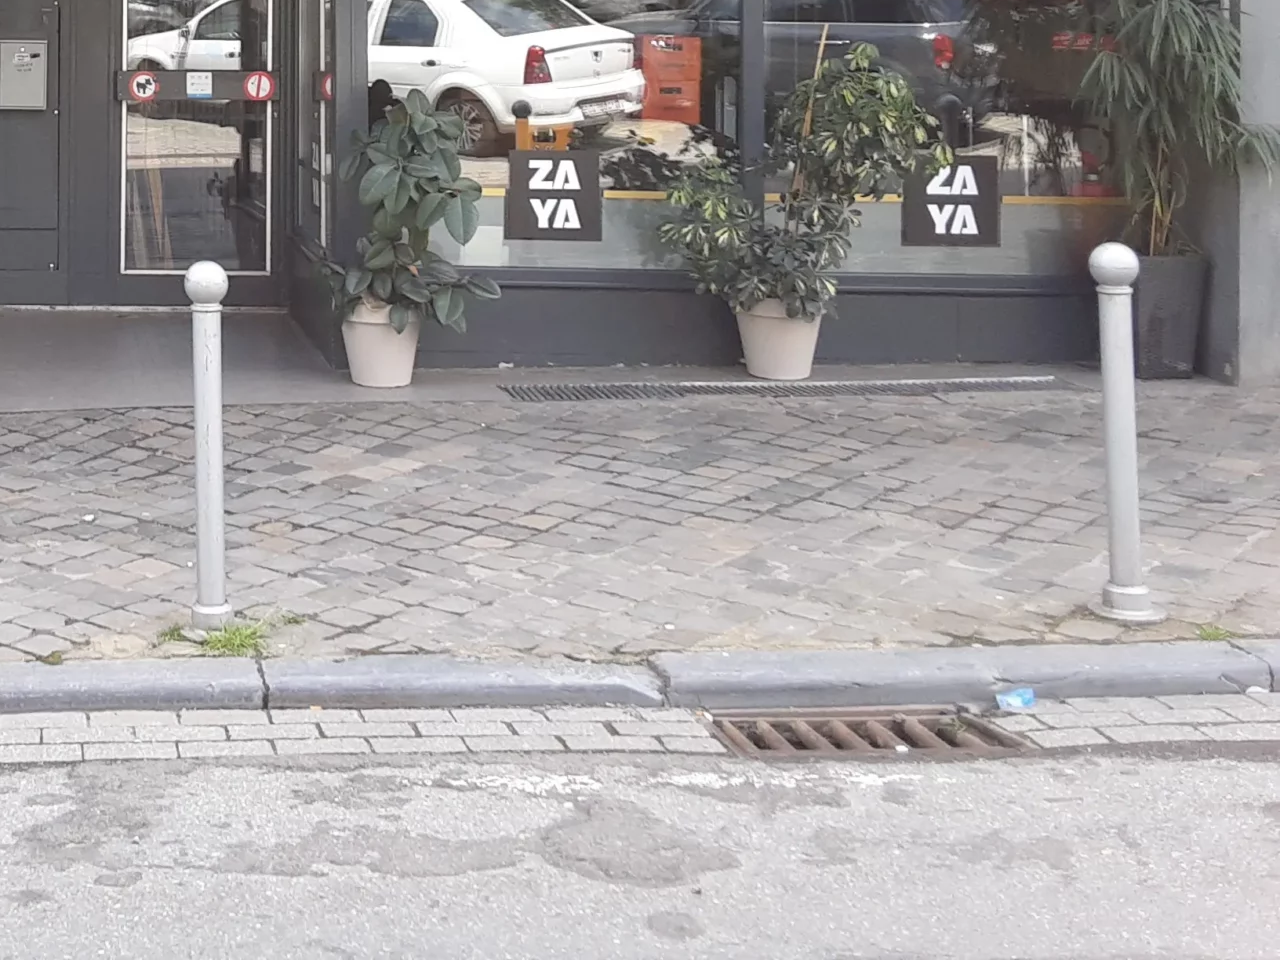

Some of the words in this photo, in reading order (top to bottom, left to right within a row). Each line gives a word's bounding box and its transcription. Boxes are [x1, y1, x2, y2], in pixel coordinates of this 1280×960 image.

[528, 159, 582, 190] ZA
[925, 165, 980, 196] ZA
[528, 198, 582, 229] YA
[925, 204, 980, 235] YA
